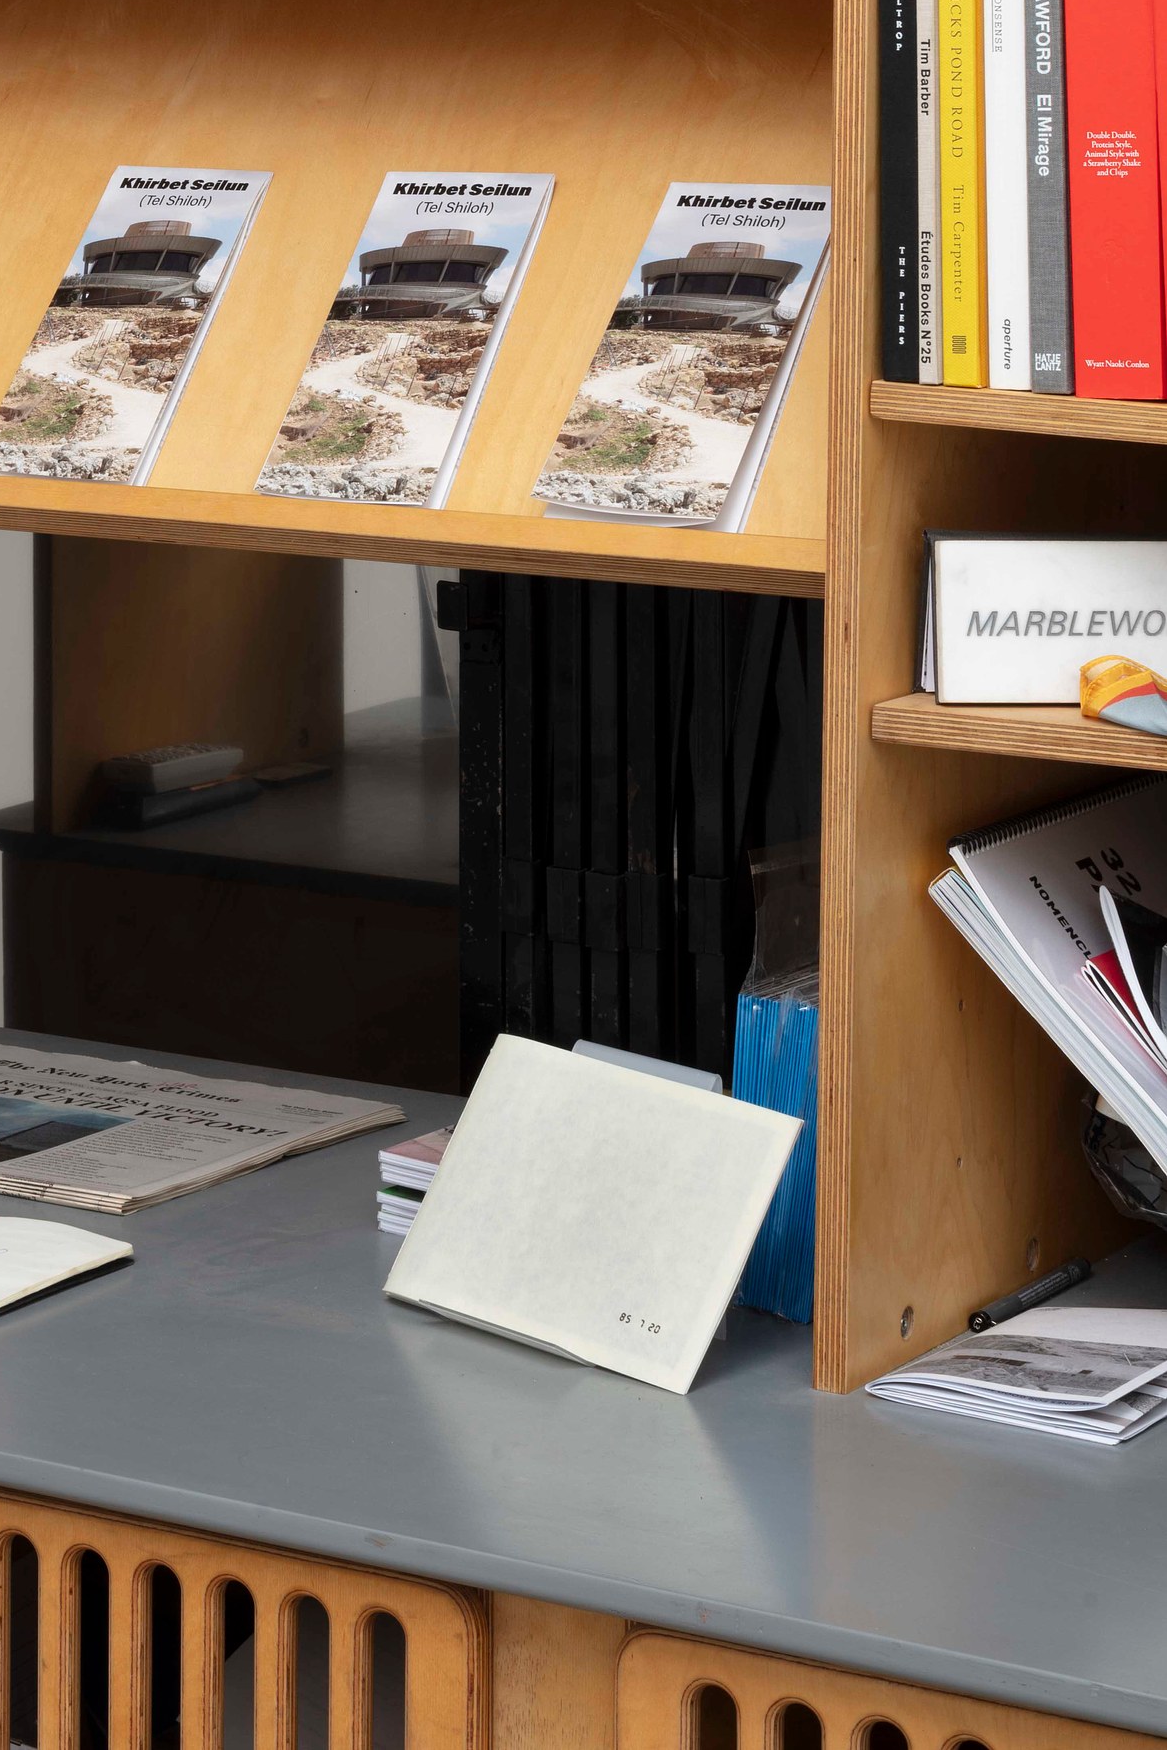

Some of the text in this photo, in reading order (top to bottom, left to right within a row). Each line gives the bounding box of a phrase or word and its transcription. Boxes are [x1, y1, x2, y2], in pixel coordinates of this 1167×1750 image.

[920, 39, 931, 64] Tim
[951, 47, 963, 98] POND
[920, 69, 931, 116] Barber
[1036, 94, 1052, 111] El
[952, 107, 963, 158] ROAD
[1034, 117, 1052, 177] Mirage
[119, 178, 249, 191] Khirbet Seilun
[393, 183, 532, 196] Khirbet Seilun
[953, 185, 964, 214] Tim
[139, 194, 212, 208] (Tel Shiloh)
[416, 201, 494, 216] (Tel Shiloh)
[676, 195, 826, 211] Khirbet Seilun
[701, 213, 786, 230] (Tel Shiloh)
[921, 231, 933, 279] Études
[950, 221, 964, 302] Carpenter
[921, 283, 932, 326] Books
[921, 330, 932, 364] N°25
[1002, 318, 1013, 370] aperture
[966, 610, 1166, 637] MARBLEWO
[33, 1093, 128, 1112] UNTIL
[133, 1109, 289, 1137] VICTORY!
